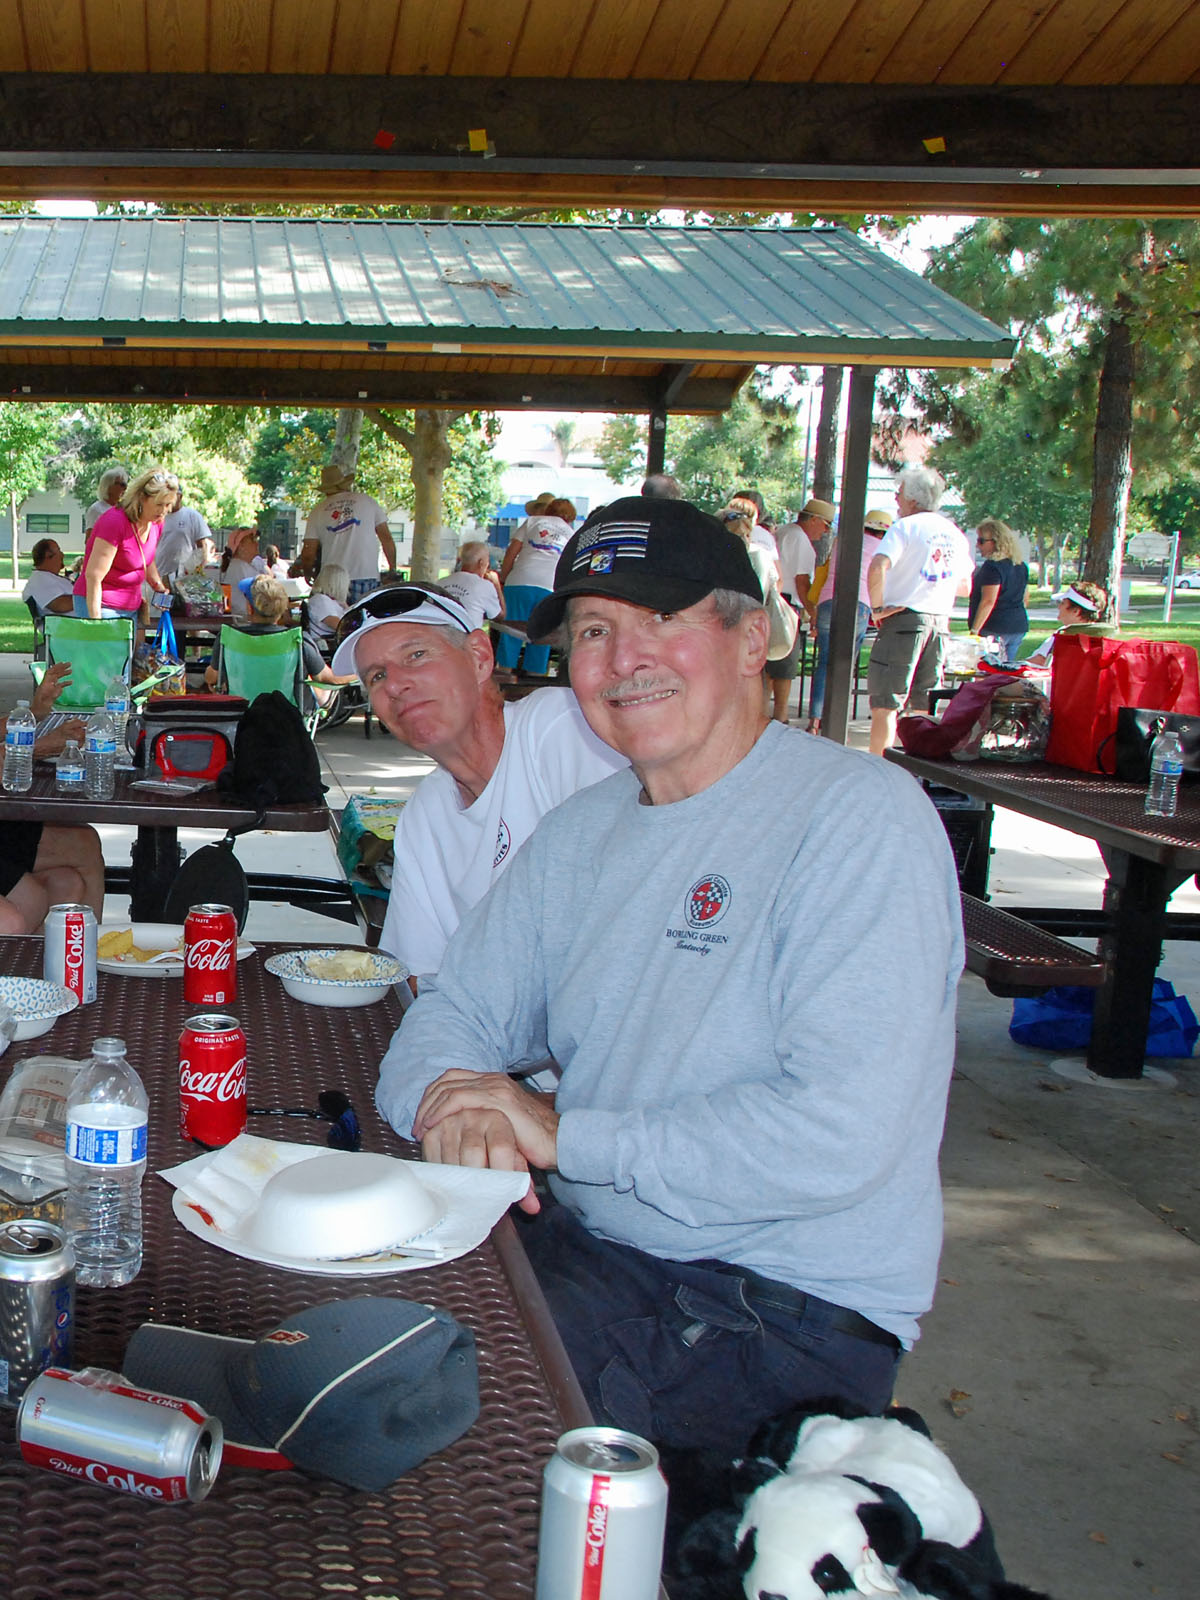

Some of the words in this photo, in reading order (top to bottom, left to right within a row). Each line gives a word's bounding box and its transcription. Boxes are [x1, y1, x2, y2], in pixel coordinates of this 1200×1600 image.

[65, 924, 84, 969] Coke
[675, 940, 712, 957] Kentucky
[700, 933, 729, 945] GREEN
[69, 968, 80, 990] Diet
[194, 1036, 224, 1044] ORIGINAL
[225, 1033, 240, 1043] TASTE
[147, 1394, 184, 1411] Coke
[49, 1457, 83, 1476] Diet
[85, 1463, 163, 1499] Coke
[586, 1504, 608, 1548] Coke
